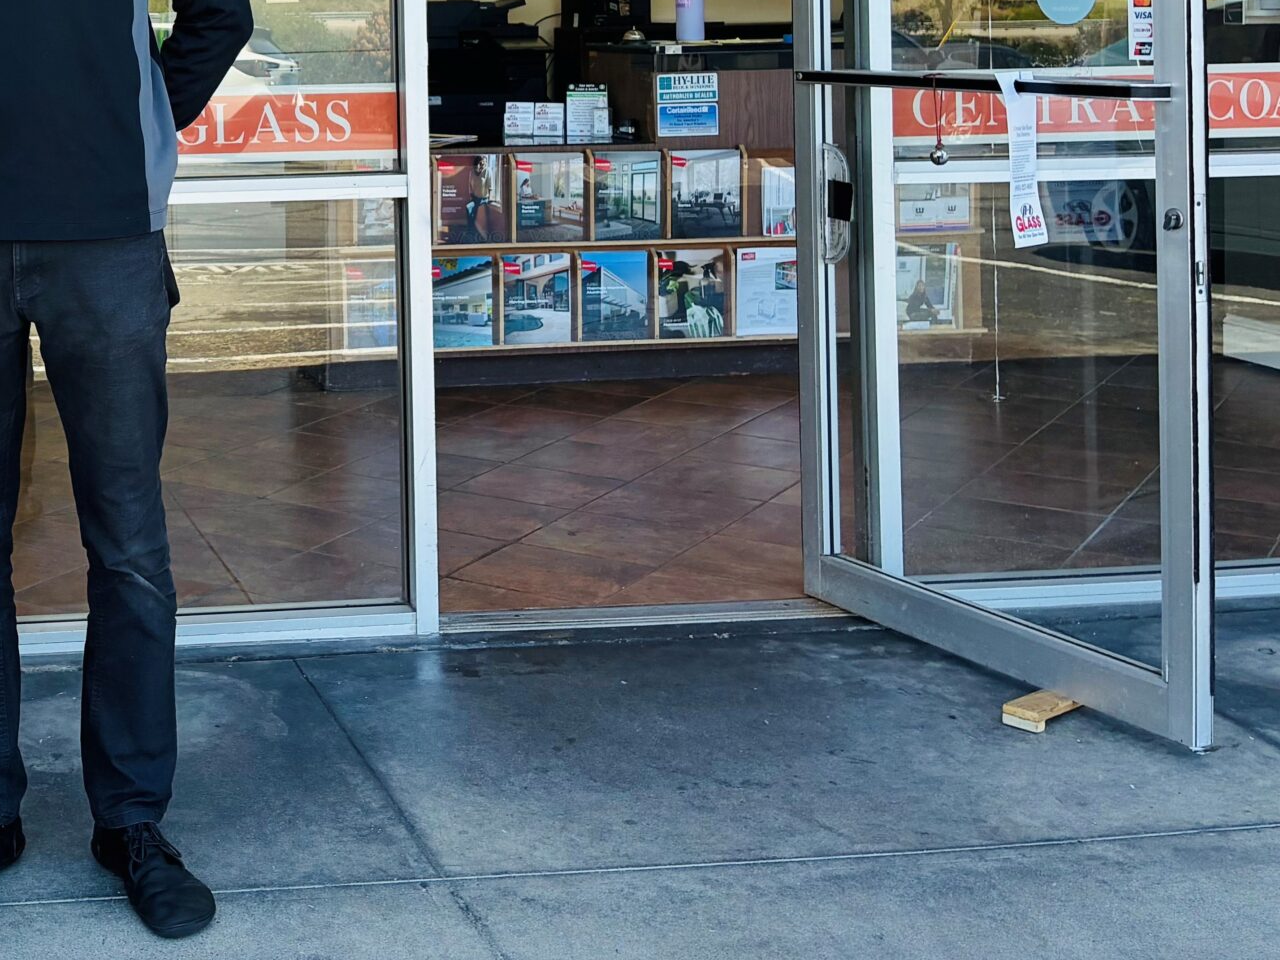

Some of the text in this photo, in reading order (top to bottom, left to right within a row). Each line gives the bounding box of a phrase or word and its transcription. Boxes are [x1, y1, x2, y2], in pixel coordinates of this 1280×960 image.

[1134, 11, 1152, 19] VISA
[673, 74, 714, 86] HY-LITE
[912, 78, 1280, 128] CETRA CO
[1015, 215, 1042, 233] GLASS
